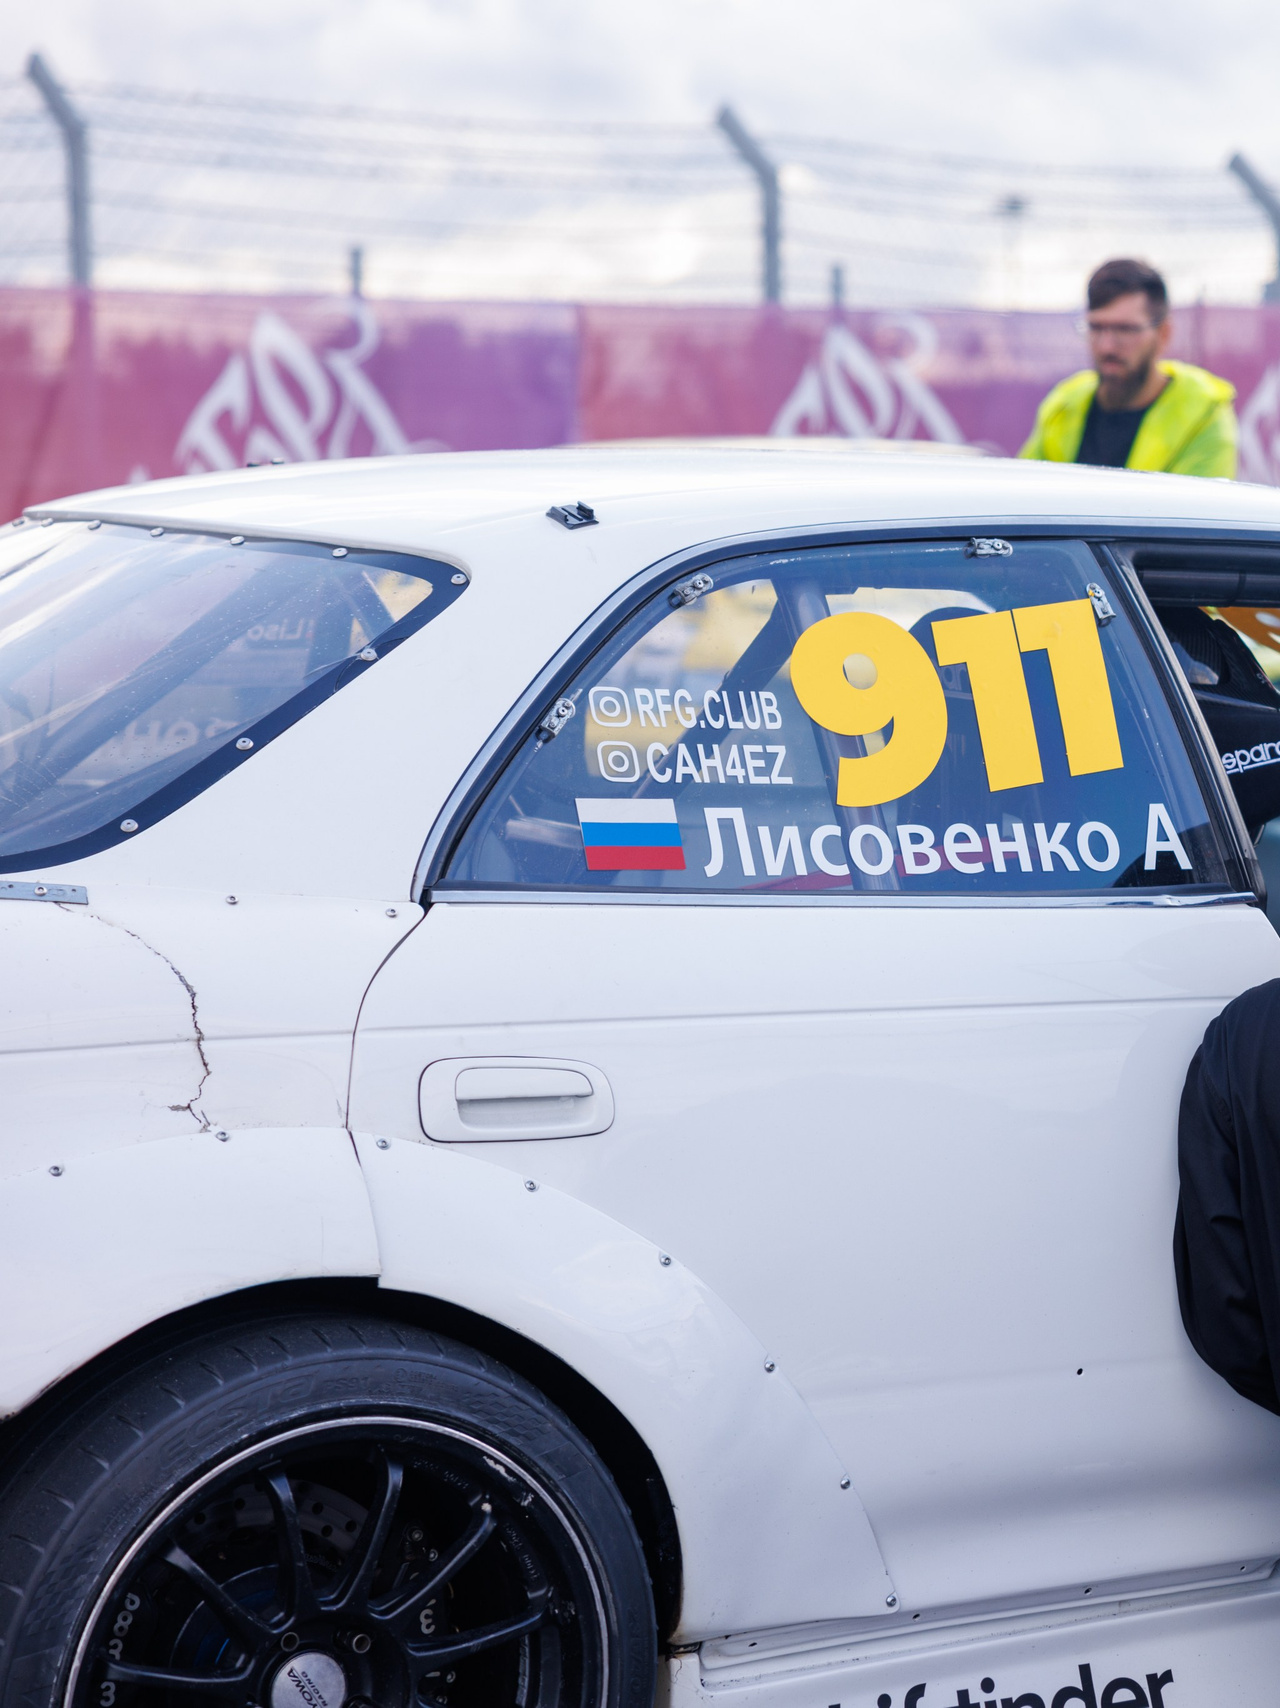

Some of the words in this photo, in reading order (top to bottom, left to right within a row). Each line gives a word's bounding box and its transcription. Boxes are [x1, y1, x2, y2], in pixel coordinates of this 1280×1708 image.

[635, 686, 783, 730] RFG.CLUB
[790, 598, 1124, 807] 911
[646, 742, 794, 785] CAH4EZ
[703, 807, 1121, 878] Лисовенко
